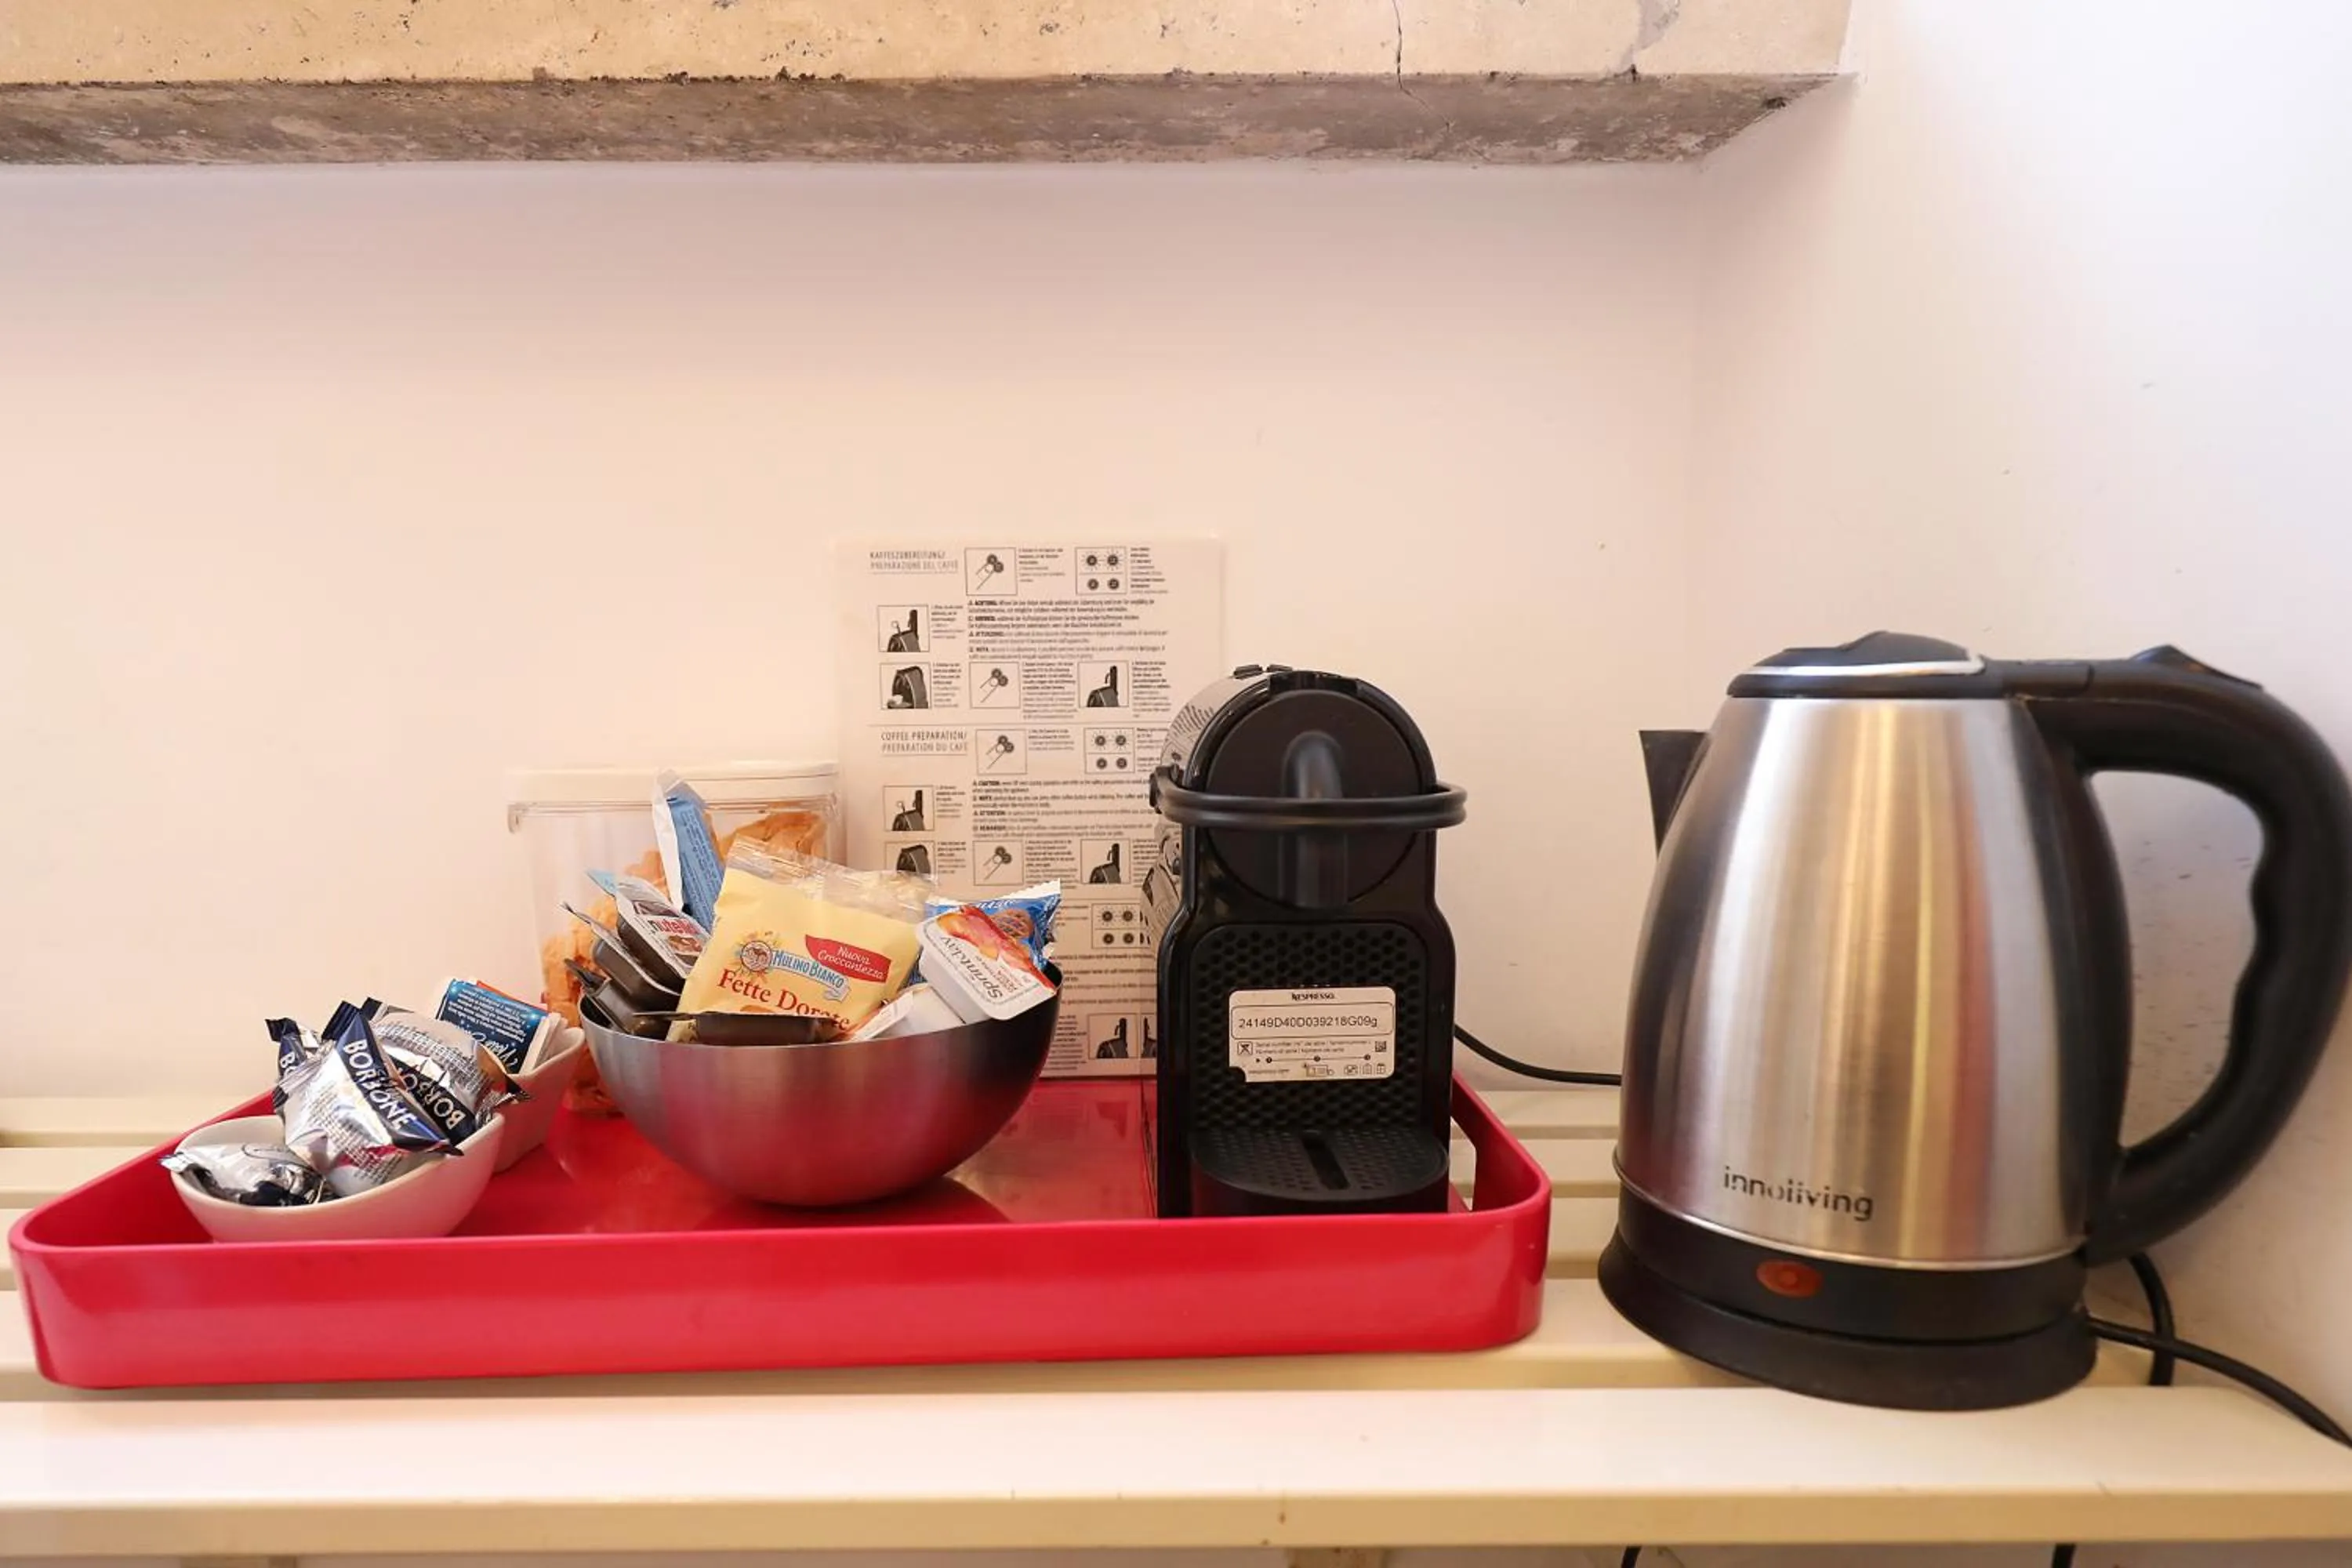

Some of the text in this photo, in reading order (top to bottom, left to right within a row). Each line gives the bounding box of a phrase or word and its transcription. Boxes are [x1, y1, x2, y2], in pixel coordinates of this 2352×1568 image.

[772, 949, 845, 989] MULINO BIANCO
[837, 946, 872, 965] Nuova
[717, 968, 851, 1031] Fette Dorte
[344, 1039, 417, 1131] BORBONE
[398, 1068, 468, 1131] BORBO
